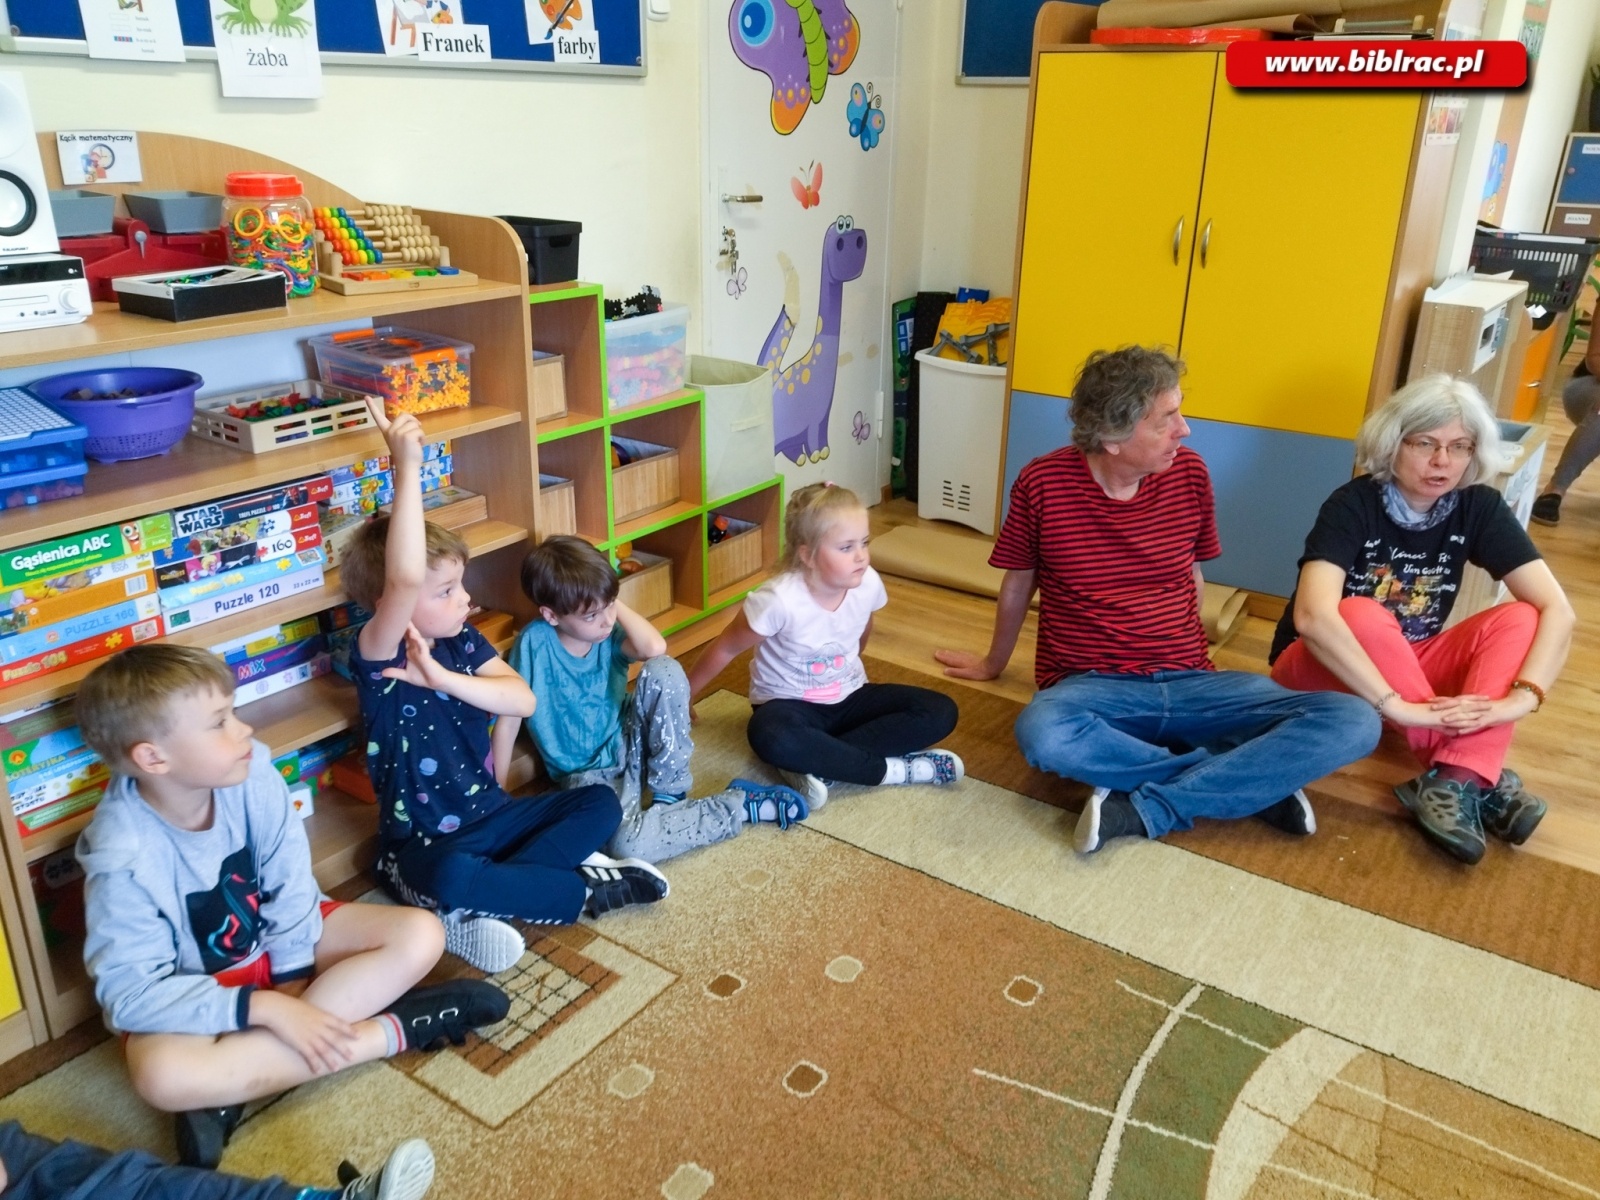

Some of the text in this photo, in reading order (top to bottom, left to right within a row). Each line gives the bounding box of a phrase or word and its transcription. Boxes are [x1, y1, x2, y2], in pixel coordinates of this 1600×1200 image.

[421, 32, 485, 53] Franek
[557, 36, 596, 59] farby
[246, 47, 288, 66] żaba
[59, 134, 133, 142] Kącik matematyczny
[179, 505, 223, 524] STAR
[180, 515, 224, 534] WARS
[11, 544, 80, 571] Gąsienica
[82, 533, 112, 553] ABC
[272, 539, 293, 553] 160
[215, 582, 280, 614] Puzzle 120
[65, 608, 135, 637] PUZZLE 160
[2, 650, 69, 682] Puzzle 104
